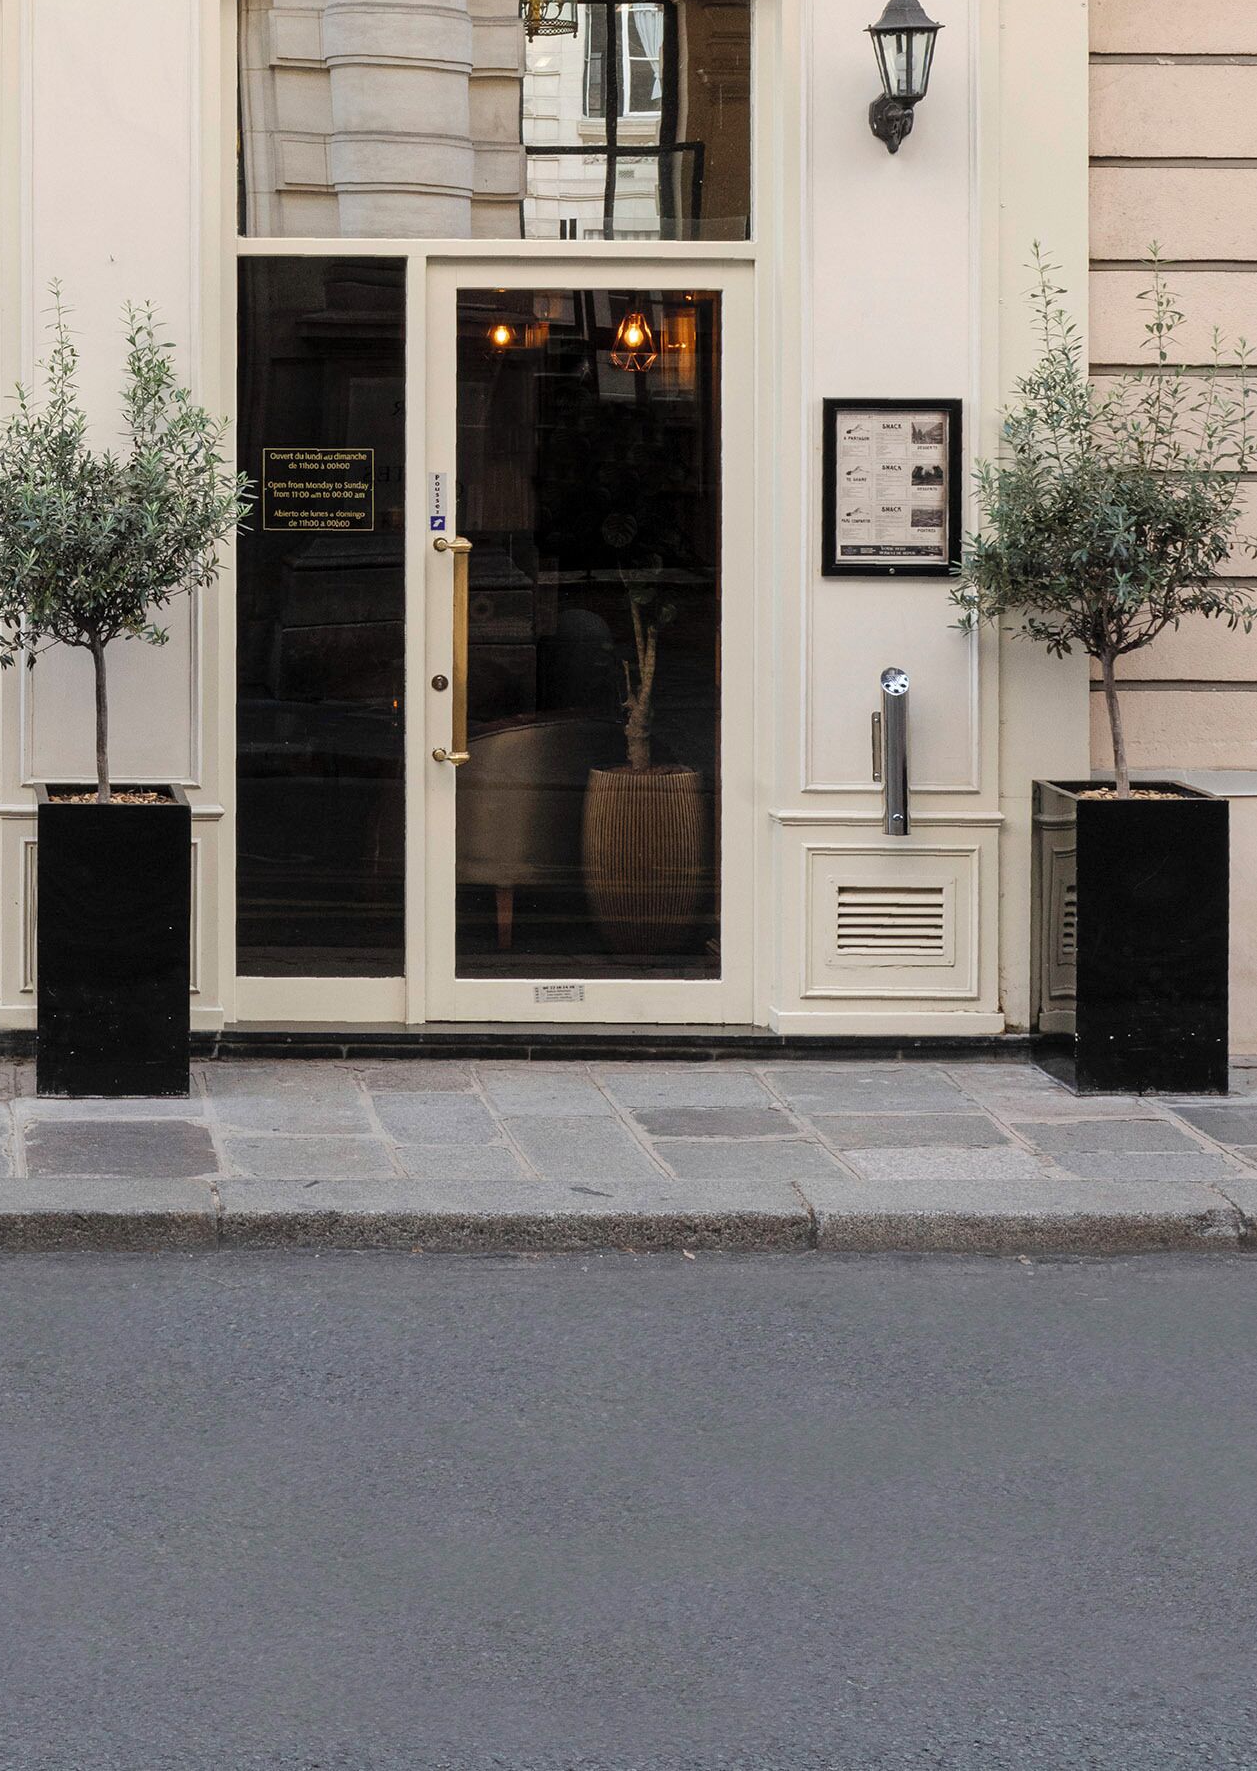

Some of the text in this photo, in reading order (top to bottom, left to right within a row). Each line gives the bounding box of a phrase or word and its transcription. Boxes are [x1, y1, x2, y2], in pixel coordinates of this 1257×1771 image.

[270, 452, 293, 460] Ouvert
[295, 452, 304, 460] du
[305, 452, 323, 460] lundi
[334, 452, 367, 460] dimanche
[288, 462, 297, 470] de
[299, 462, 319, 470] 11h00
[326, 462, 350, 470] 00h00
[267, 481, 369, 490] Open from Monday to Sunday
[336, 510, 366, 519] domingo
